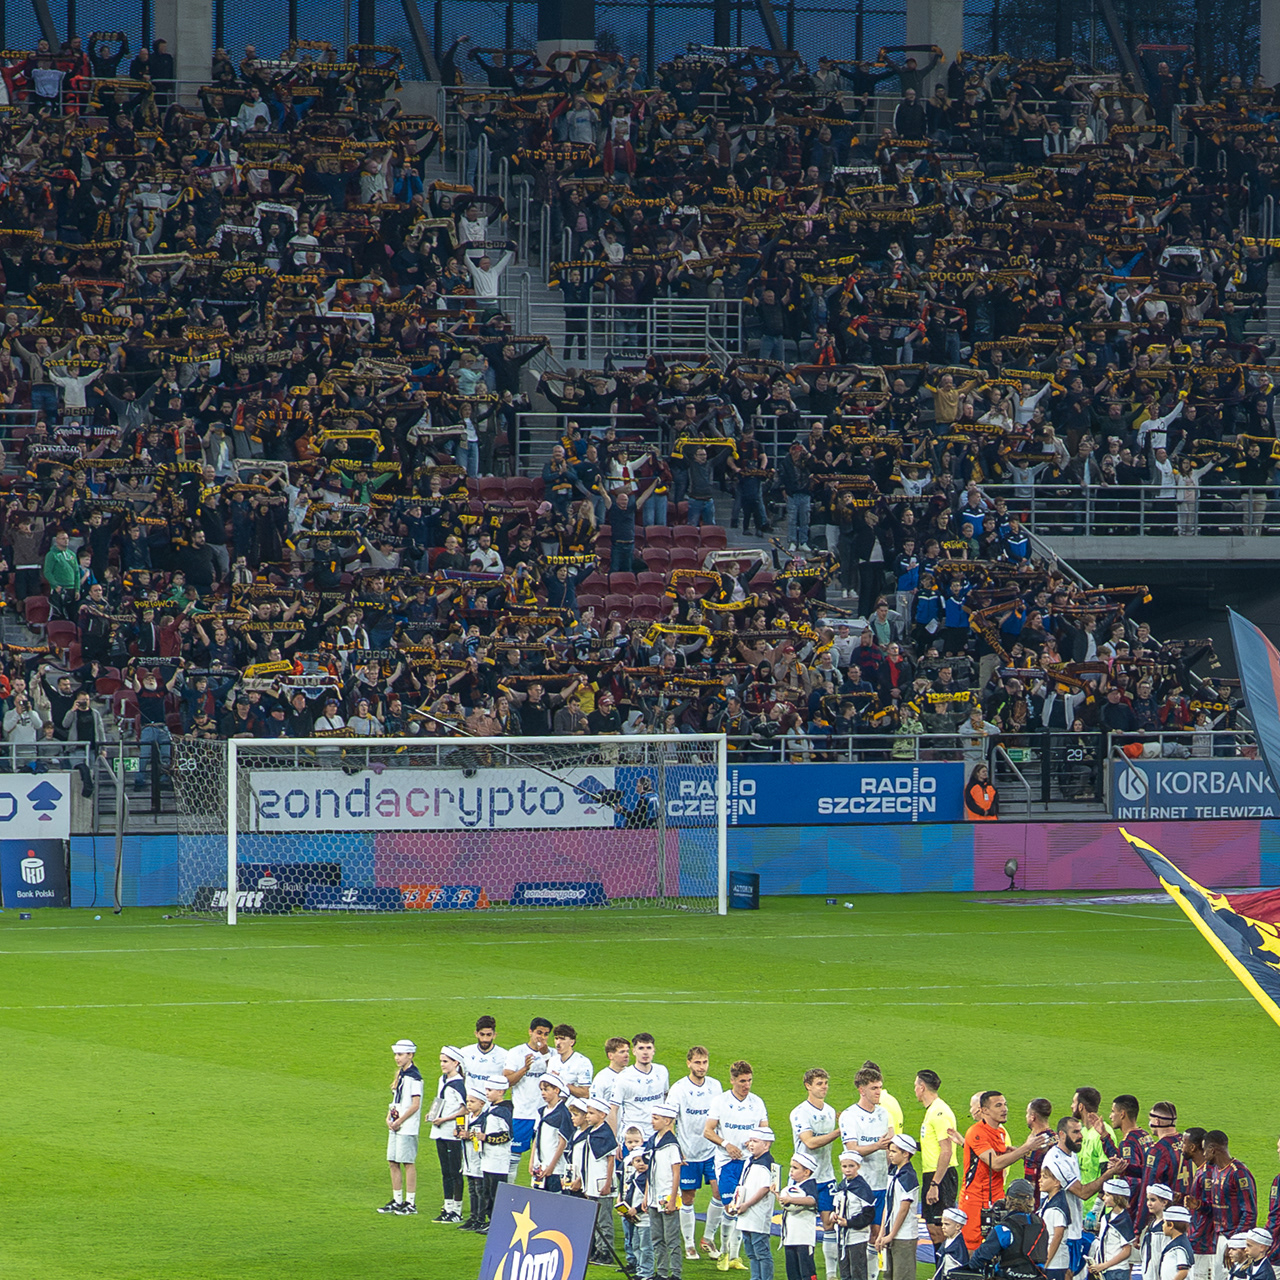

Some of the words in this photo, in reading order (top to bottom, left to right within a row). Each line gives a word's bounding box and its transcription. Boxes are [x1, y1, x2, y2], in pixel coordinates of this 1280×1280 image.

[1067, 749, 1083, 761] 29
[258, 778, 565, 827] zondacrypto
[818, 797, 936, 817] SZCZECIN
[1195, 806, 1274, 819] TELEWIZJA
[16, 890, 34, 899] Bank
[1176, 1152, 1190, 1187] 4
